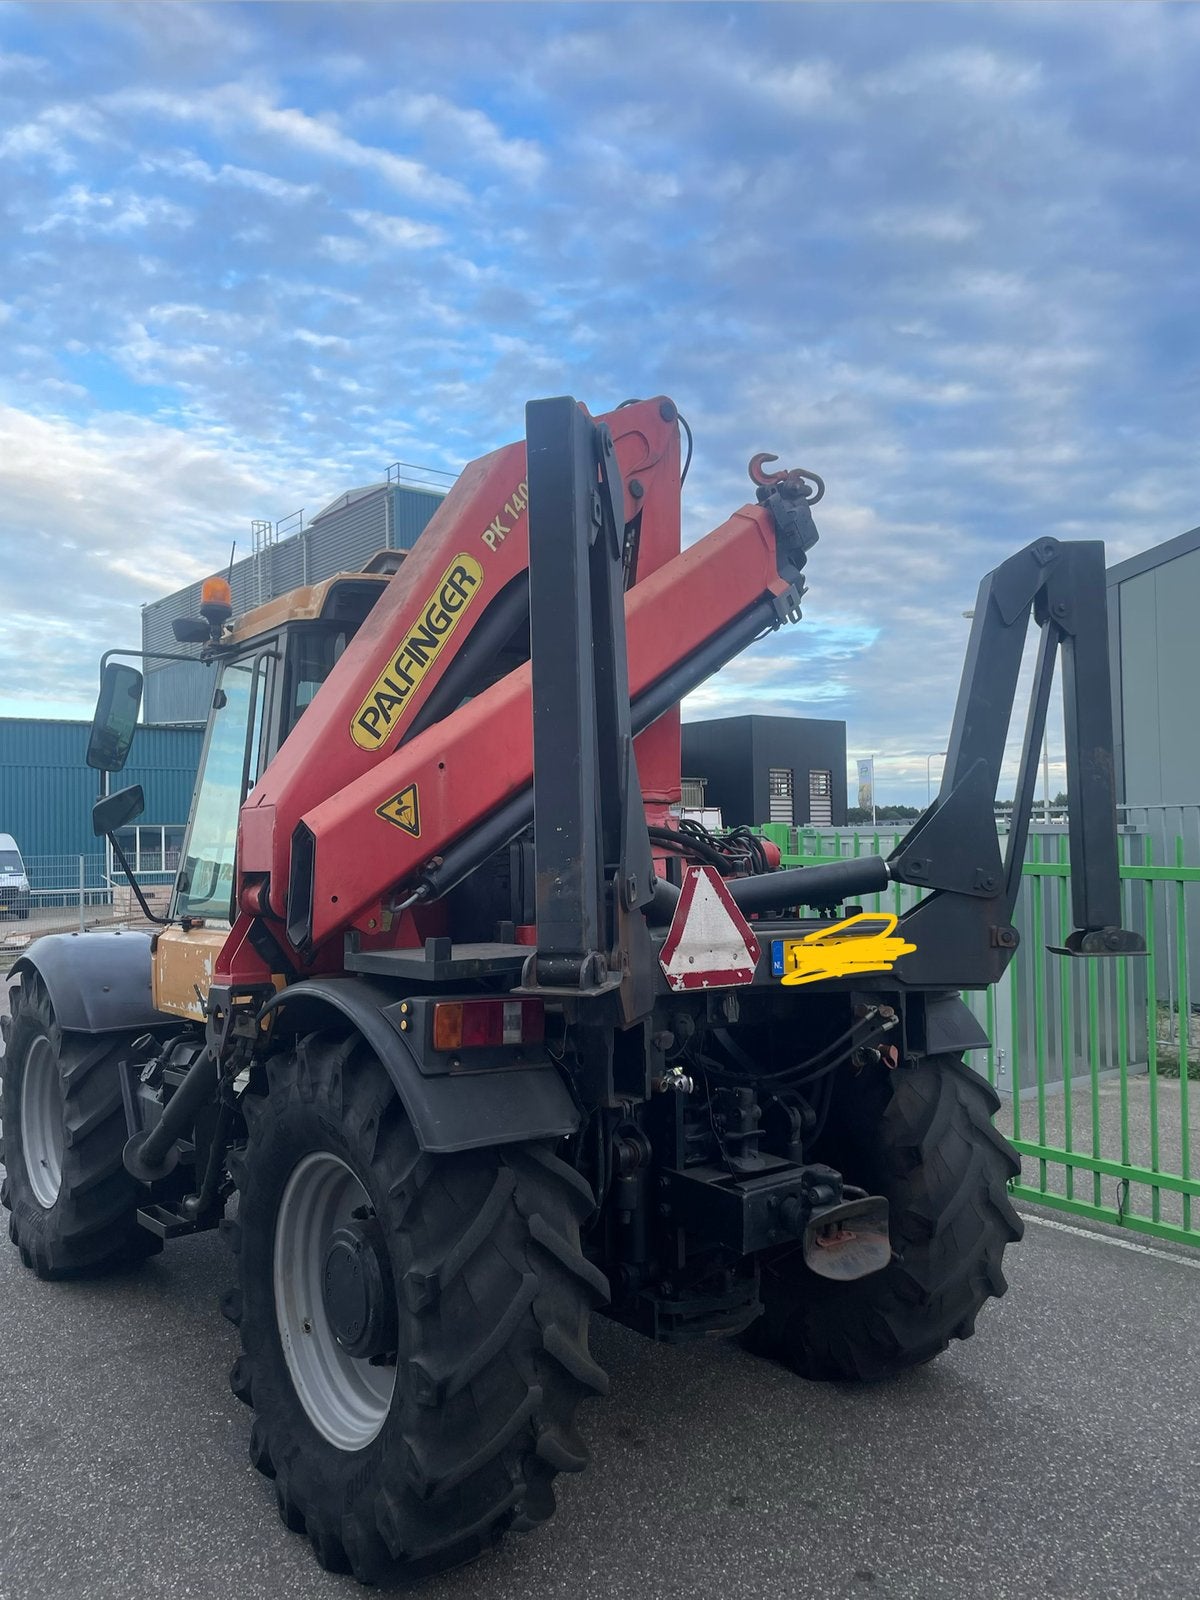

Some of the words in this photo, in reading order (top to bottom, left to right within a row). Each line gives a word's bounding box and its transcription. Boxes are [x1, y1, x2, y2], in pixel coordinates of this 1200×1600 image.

[481, 514, 511, 552] PK
[358, 565, 477, 739] PALFINGER
[773, 961, 783, 969] NL
